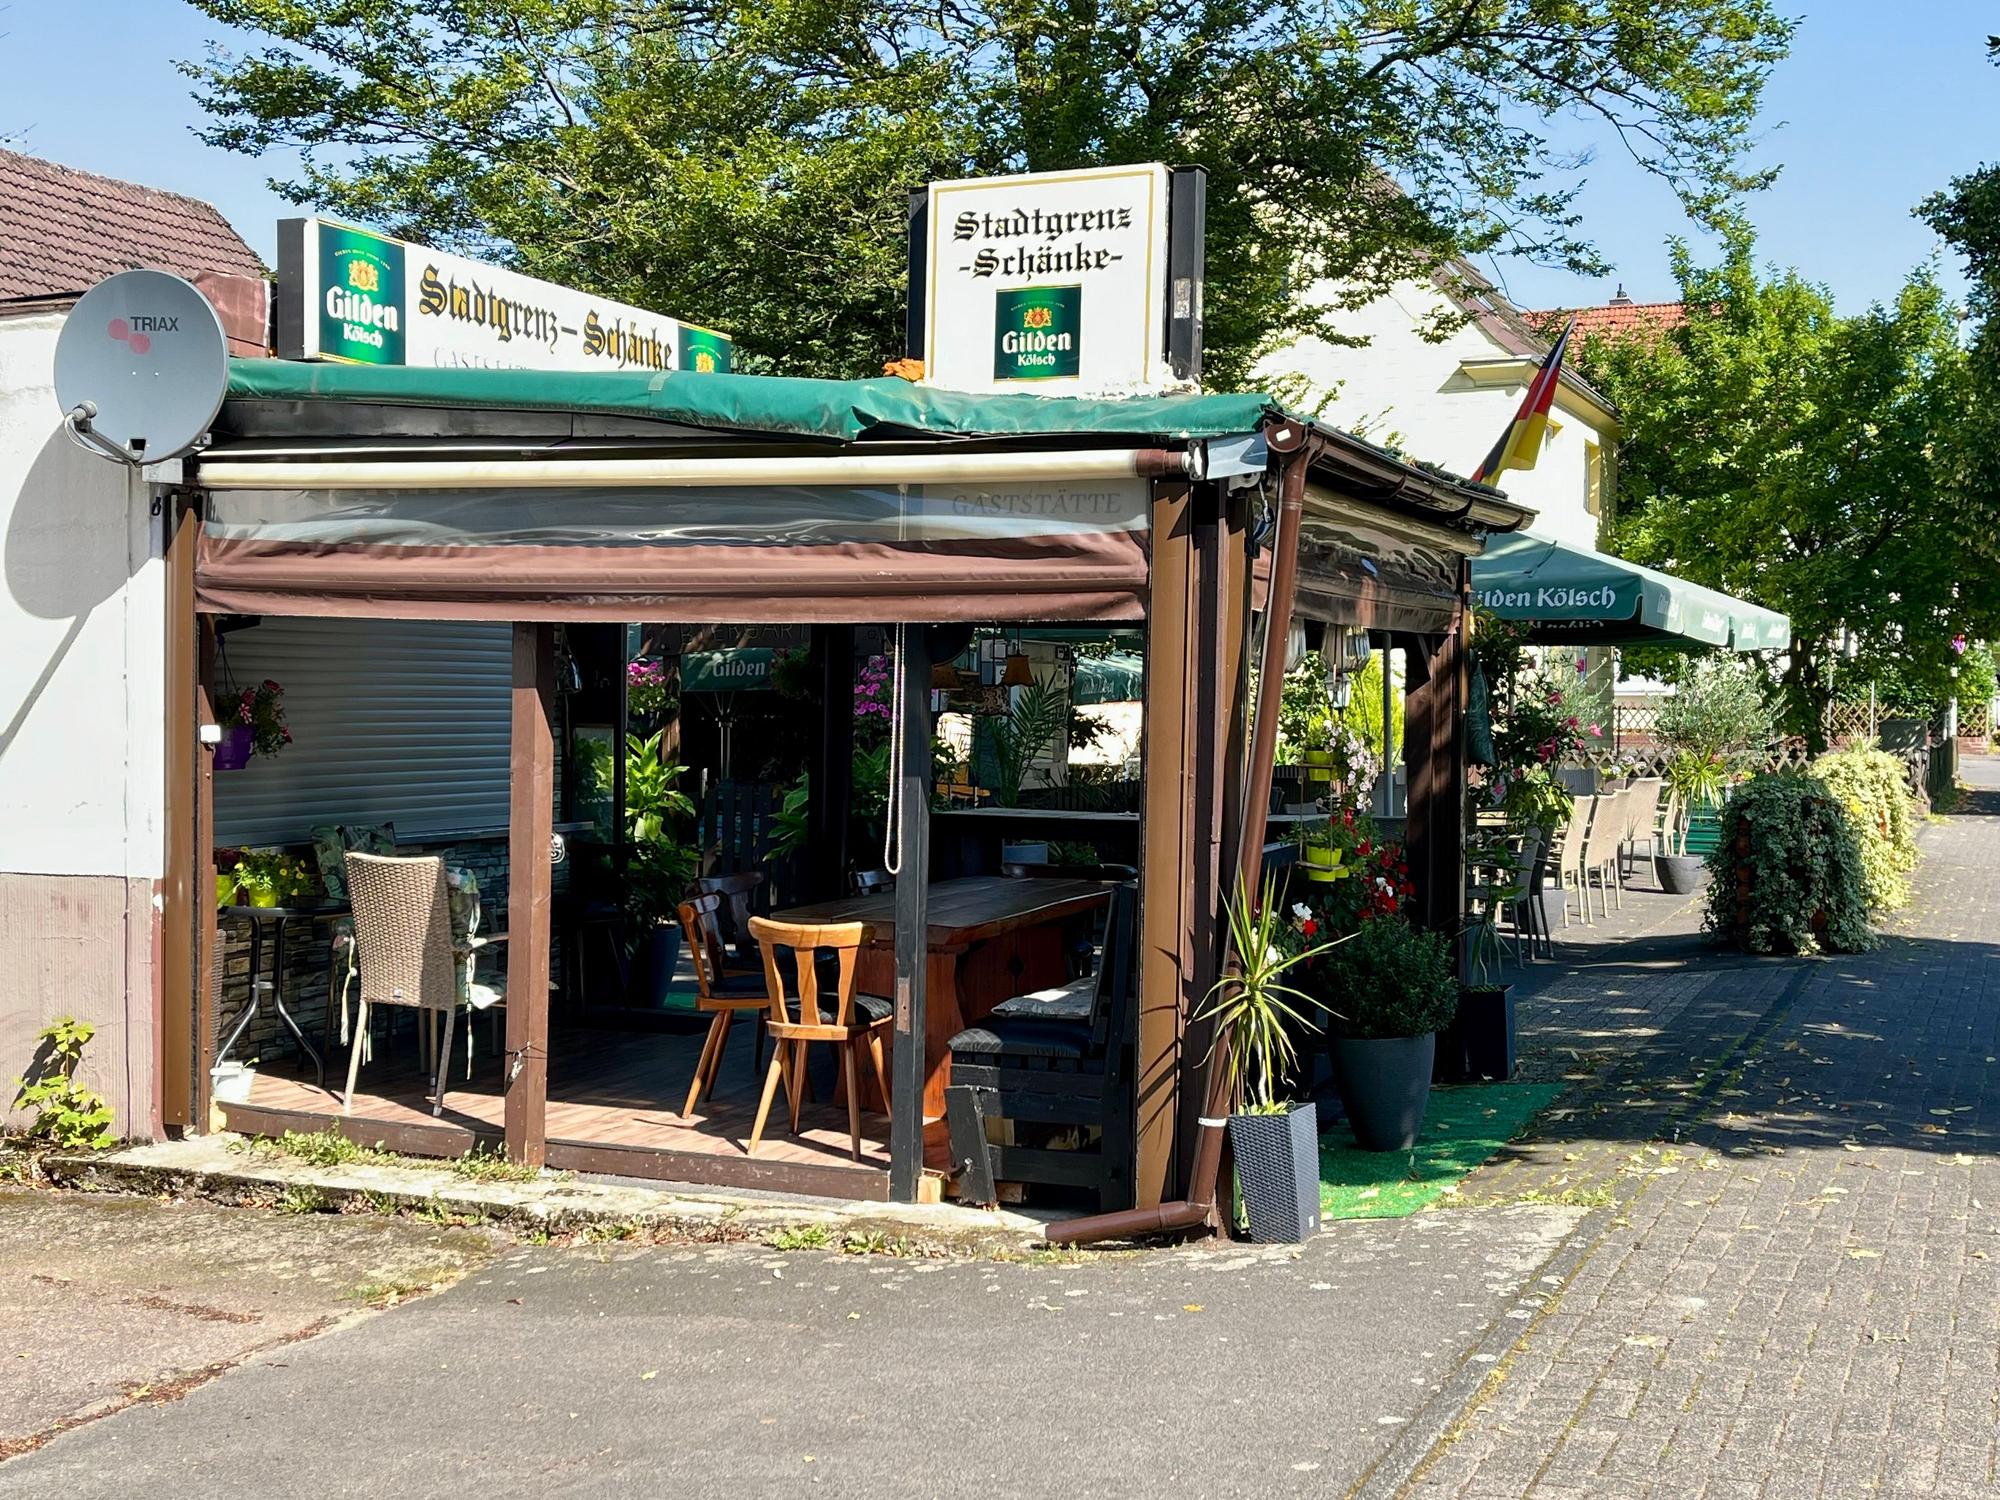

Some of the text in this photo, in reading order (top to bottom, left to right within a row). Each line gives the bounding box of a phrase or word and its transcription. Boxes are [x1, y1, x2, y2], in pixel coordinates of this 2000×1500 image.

[952, 206, 1132, 242] Stadtgrenz
[326, 285, 399, 331] Gilden
[130, 316, 179, 331] TRIAX
[343, 322, 383, 349] Kölsch
[1002, 330, 1072, 354] Gilden
[1017, 352, 1056, 367] Kölsch
[952, 488, 1122, 516] GASTSTÄTTE
[1477, 586, 1617, 609] ilden Kölsch
[712, 659, 766, 678] Gilden
